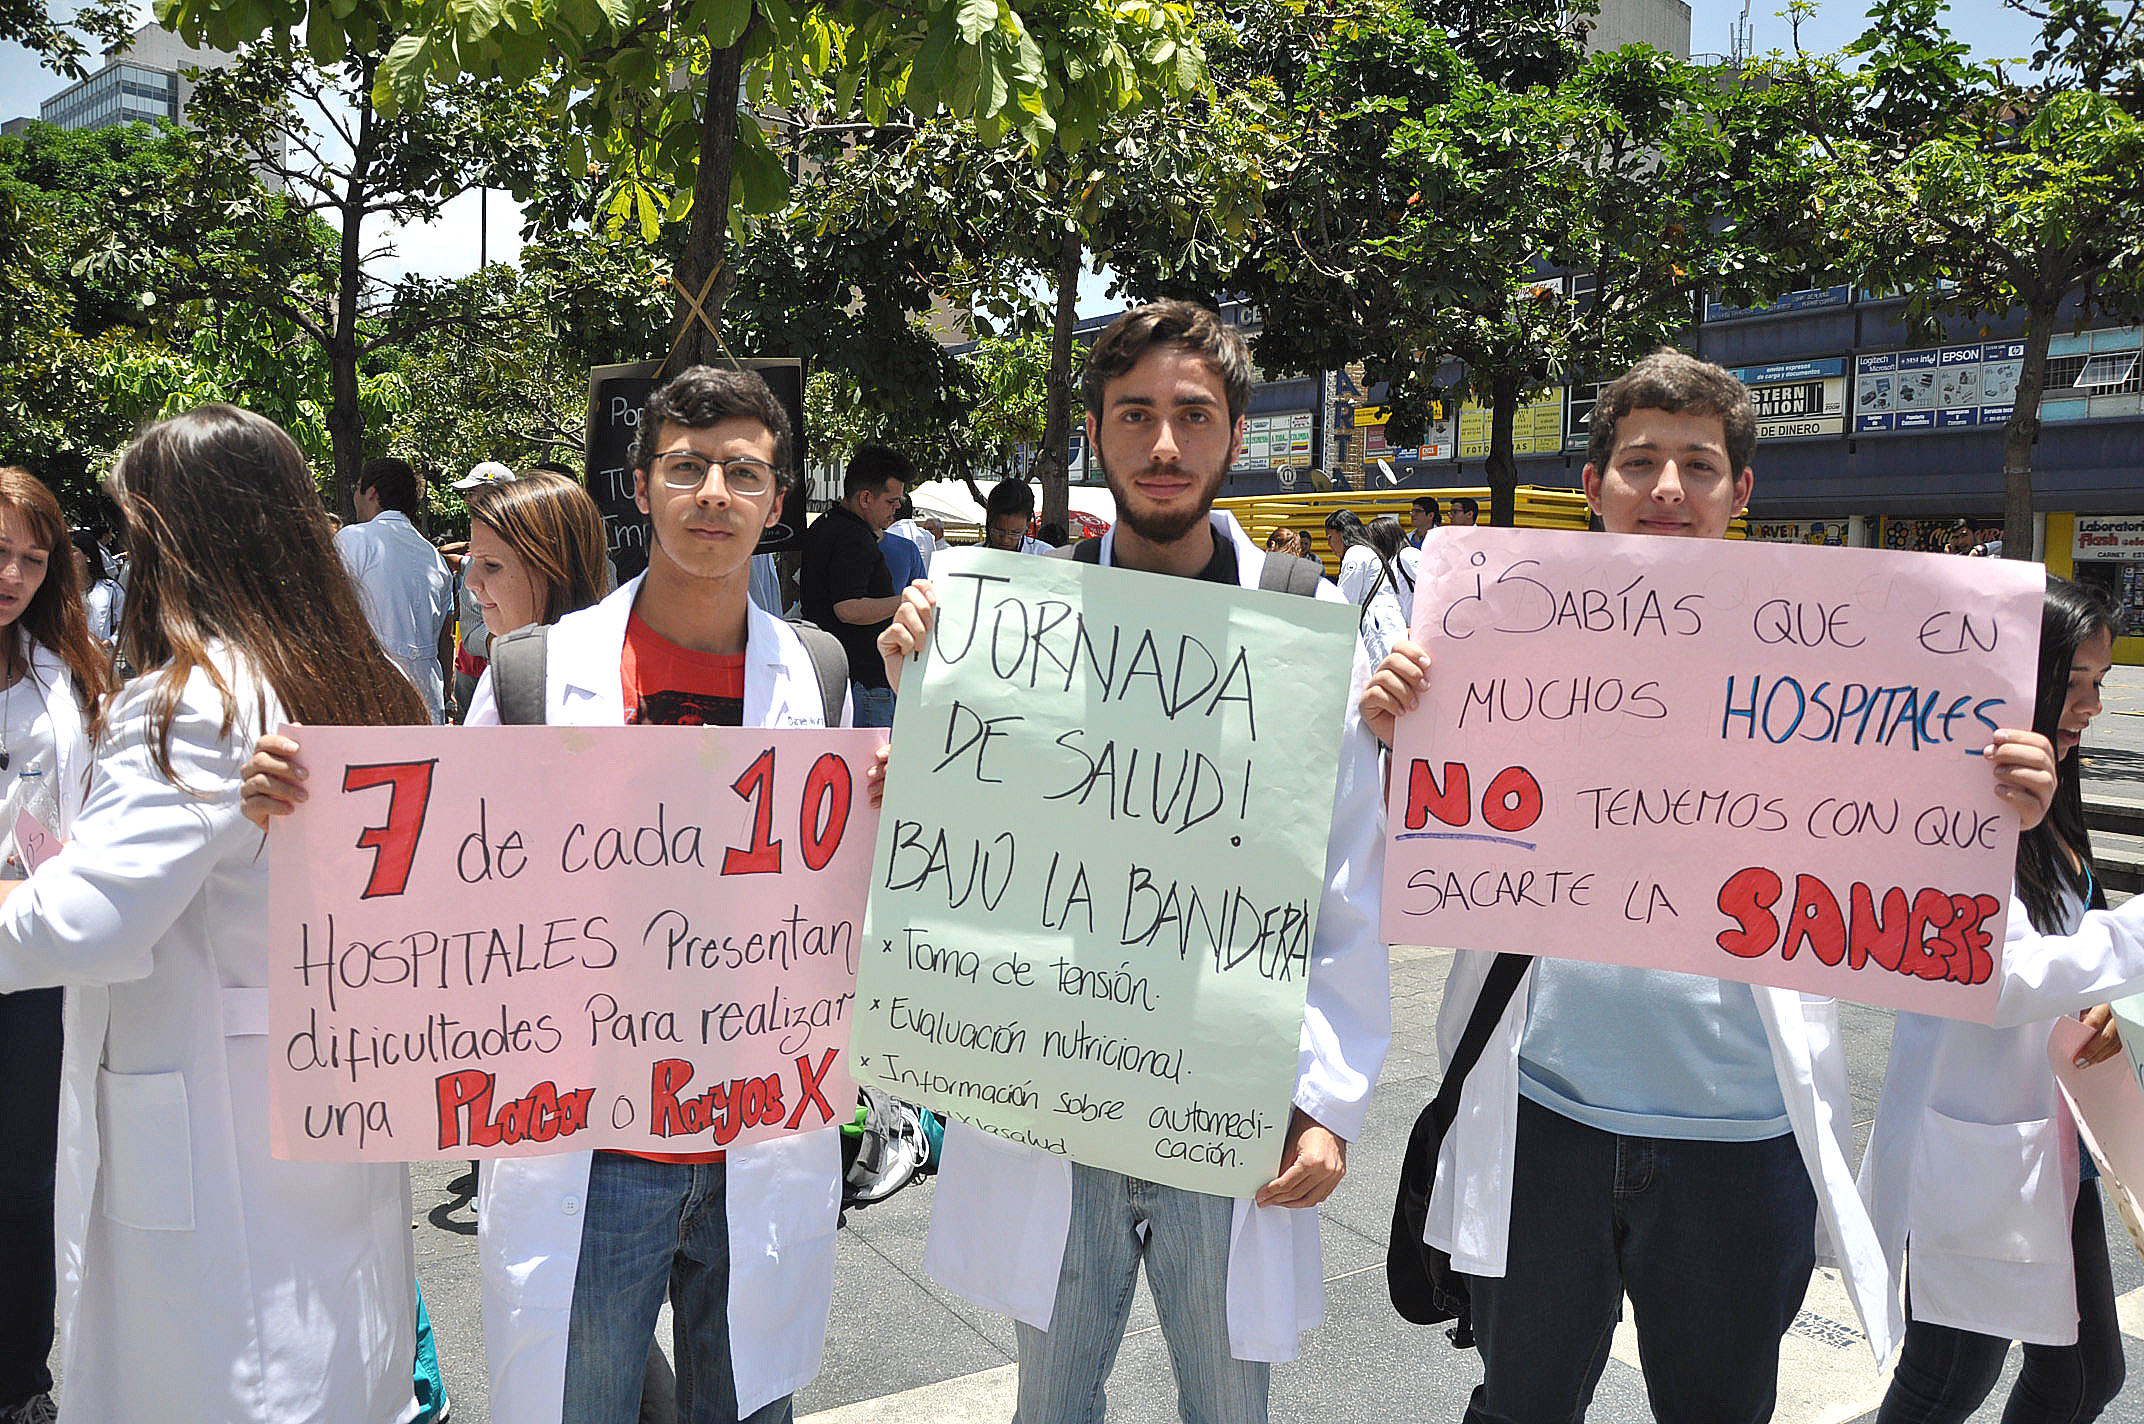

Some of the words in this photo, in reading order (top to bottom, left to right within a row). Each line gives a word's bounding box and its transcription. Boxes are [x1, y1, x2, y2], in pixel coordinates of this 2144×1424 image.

[1752, 385, 1805, 403] STERN
[1765, 371, 1781, 379] carga
[1785, 369, 1821, 377] documentos
[1785, 363, 1811, 371] expresos
[1860, 355, 1889, 365] Logitech
[1869, 364, 1896, 372] Microsoft
[1920, 353, 1936, 364] intel
[1942, 348, 1980, 363] EPSON
[1752, 400, 1804, 416] UNION
[1761, 426, 1776, 437] DE
[1778, 423, 1820, 436] DINERO
[913, 572, 1257, 742] JORNADA
[1754, 599, 1866, 648] QUE
[1916, 610, 1998, 654] EN
[1459, 677, 1668, 729] MUCHOS
[1721, 675, 2007, 756] HOSPITALES
[932, 700, 1025, 783] DE
[1043, 729, 1252, 847] SALUD!
[1405, 757, 1543, 833] NO
[1578, 785, 1788, 831] TENEMOS
[1808, 797, 1896, 839] CON
[1915, 806, 2001, 850] QUE
[342, 758, 439, 899] 7
[457, 798, 527, 883] de
[562, 803, 704, 873] cada
[720, 746, 852, 876] 10
[885, 819, 1015, 911] BAJO
[1043, 851, 1094, 932] LA
[1120, 863, 1309, 982] BANDERA
[1402, 868, 1595, 916] SACARTE
[1624, 878, 1678, 923] LA
[1717, 865, 2000, 985] SANGRE
[294, 914, 617, 1010] HOSPITALES
[643, 905, 856, 975] Presentan
[903, 928, 979, 978] Toma
[991, 952, 1034, 987] de
[1056, 956, 1160, 1012] tensión.
[287, 1005, 562, 1082] dificultades
[585, 994, 684, 1048] Para
[890, 997, 1026, 1055] Evaluación
[1043, 1020, 1192, 1085] nutricional.
[304, 1101, 394, 1149] una
[611, 1095, 636, 1130] o
[650, 1058, 785, 1145] Rayos
[784, 1047, 840, 1130] X
[879, 1053, 1039, 1109] Información
[1052, 1091, 1124, 1122] sobre
[1149, 1101, 1274, 1143] automedi-
[1155, 1135, 1243, 1168] cación.
